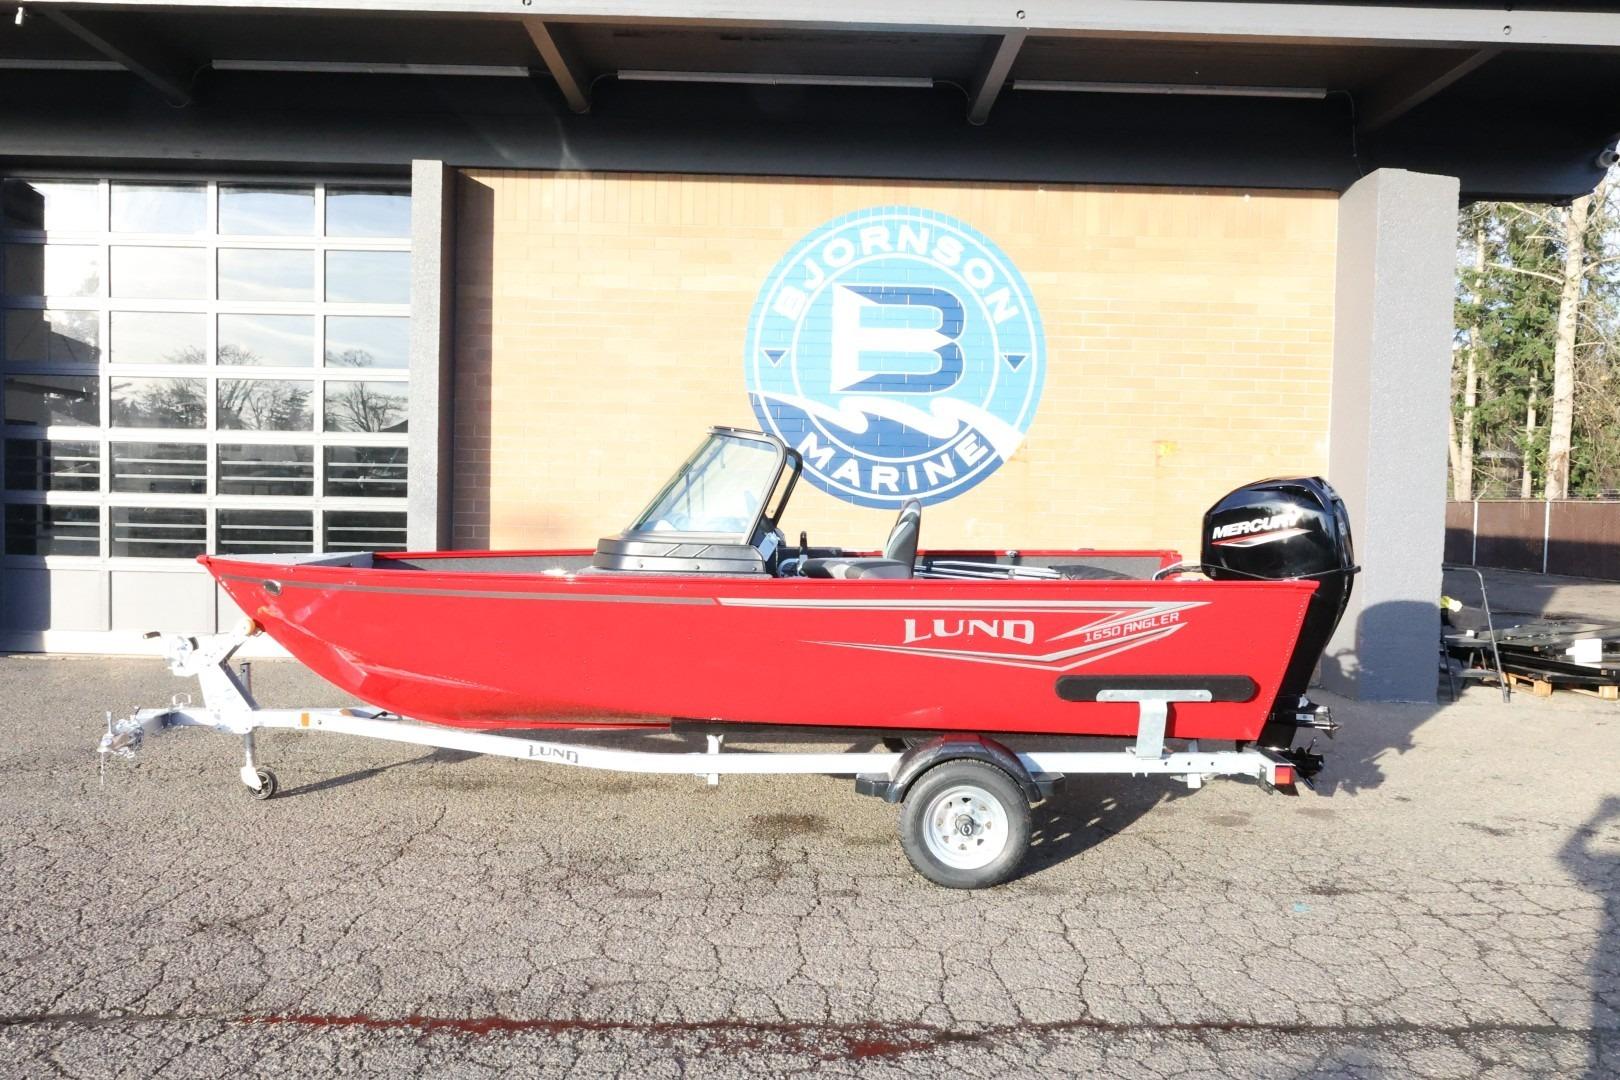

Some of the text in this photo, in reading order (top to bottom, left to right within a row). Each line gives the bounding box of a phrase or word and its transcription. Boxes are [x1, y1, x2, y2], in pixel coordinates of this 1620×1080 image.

[772, 224, 1020, 323] BJORNSON
[799, 431, 989, 492] MARINE
[903, 618, 1035, 645] LUND
[1083, 612, 1180, 643] 1650 ANGLER
[528, 744, 579, 764] LUND
